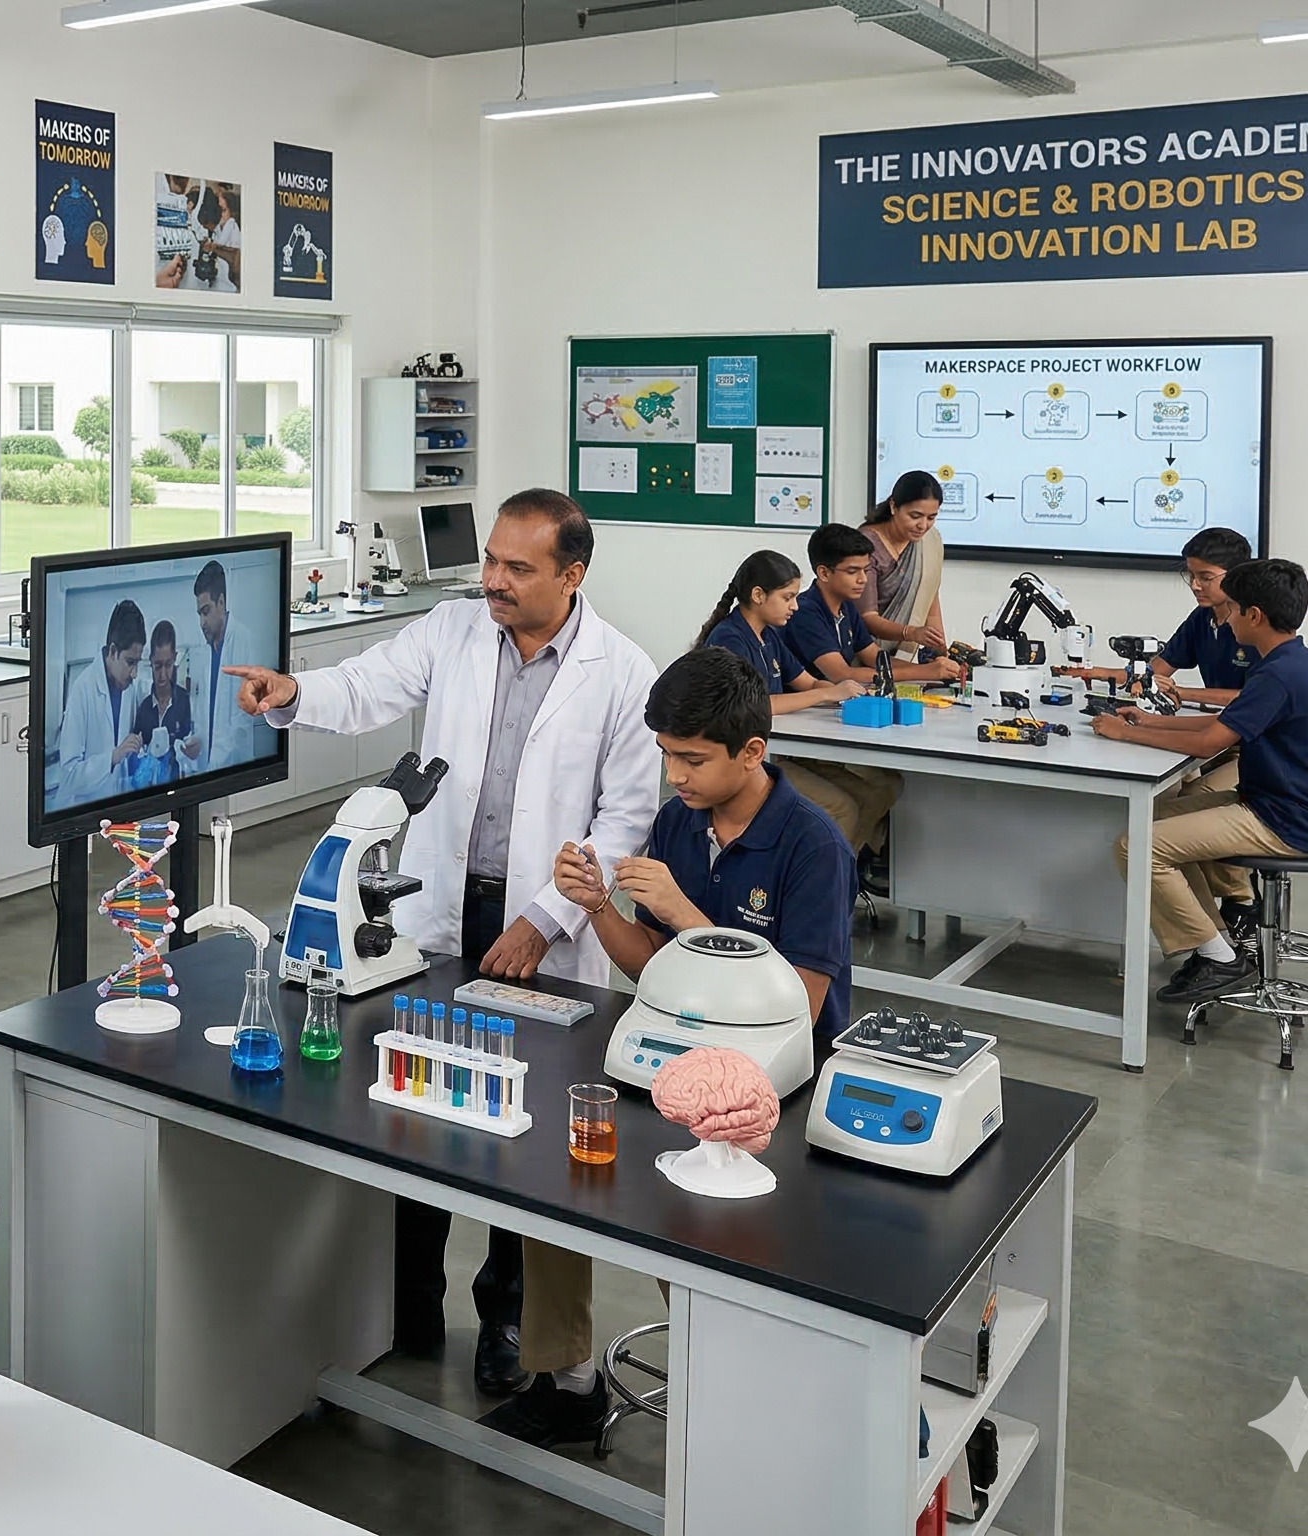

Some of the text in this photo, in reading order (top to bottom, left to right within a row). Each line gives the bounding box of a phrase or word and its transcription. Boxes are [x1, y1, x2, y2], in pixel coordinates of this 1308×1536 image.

[39, 117, 111, 146] MAKERS OF
[39, 141, 111, 170] TOMORROW
[835, 154, 901, 184] THE
[911, 135, 1148, 179] INNOVATORS
[316, 177, 329, 192] OF
[882, 169, 1305, 224] SCIENCE & ROBOTICS
[921, 218, 1258, 263] INNOVATION LAB
[924, 357, 1202, 374] MAKERSPACE PROJECT WORKFLOW
